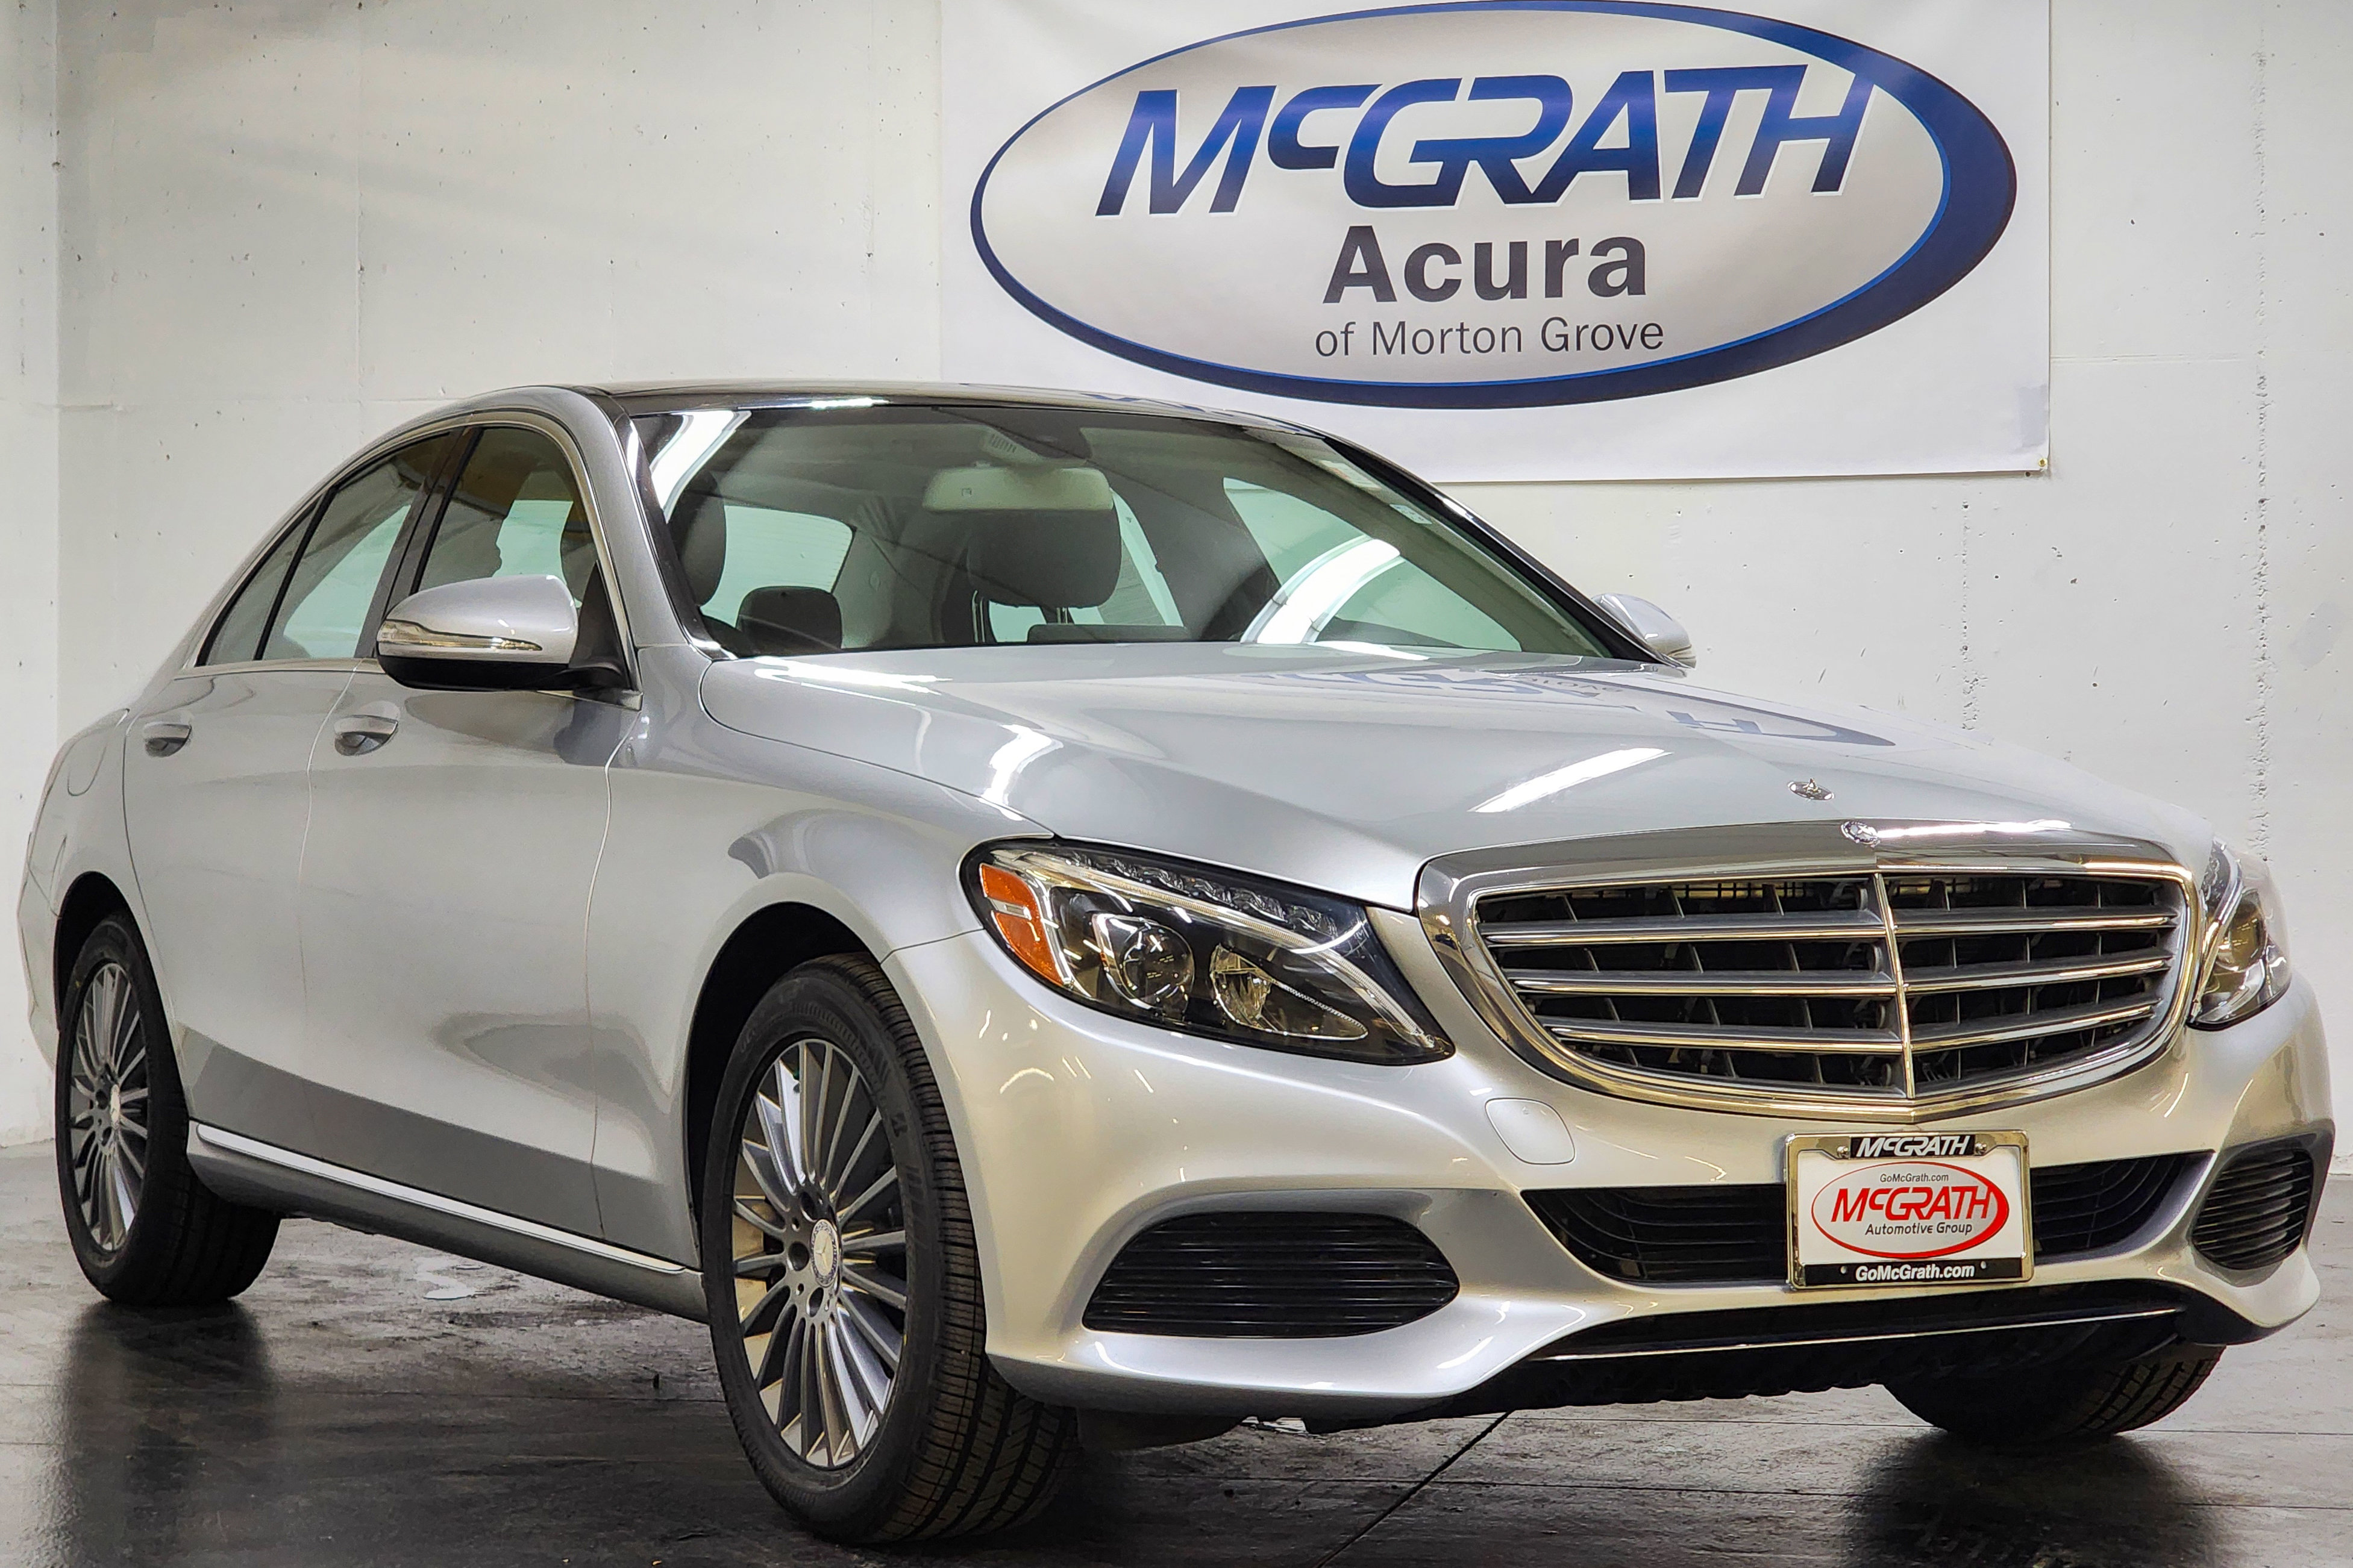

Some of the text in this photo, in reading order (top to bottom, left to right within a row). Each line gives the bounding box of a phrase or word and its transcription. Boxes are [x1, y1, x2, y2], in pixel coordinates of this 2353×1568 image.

[1323, 225, 1646, 304] Acura
[1315, 316, 1664, 357] of Morton Grove
[1879, 1173, 1949, 1183] GoMcGrath.com
[1865, 1222, 1973, 1237] Automotive Group
[1855, 1264, 1975, 1282] GoMcGrath.com
